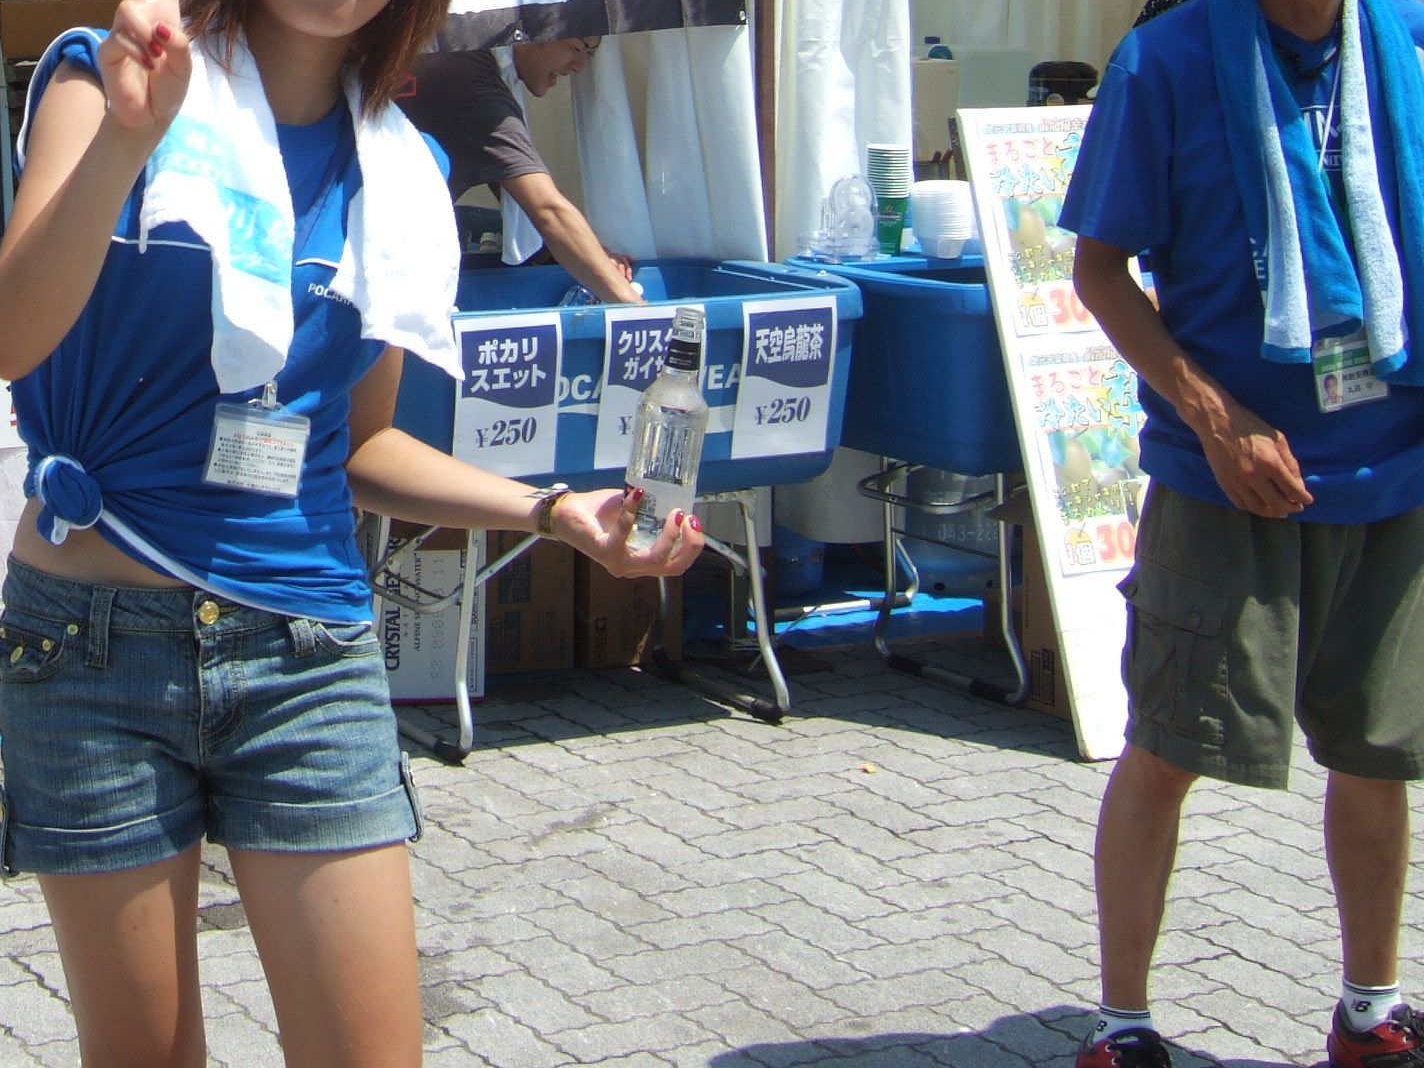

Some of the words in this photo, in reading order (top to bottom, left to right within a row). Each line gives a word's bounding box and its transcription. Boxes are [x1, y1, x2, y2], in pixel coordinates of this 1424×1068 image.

[478, 336, 539, 365] ポカリ
[469, 363, 548, 394] スエット
[755, 396, 811, 426] ¥250
[475, 416, 538, 448] ¥250
[384, 606, 401, 672] CRYSTAL
